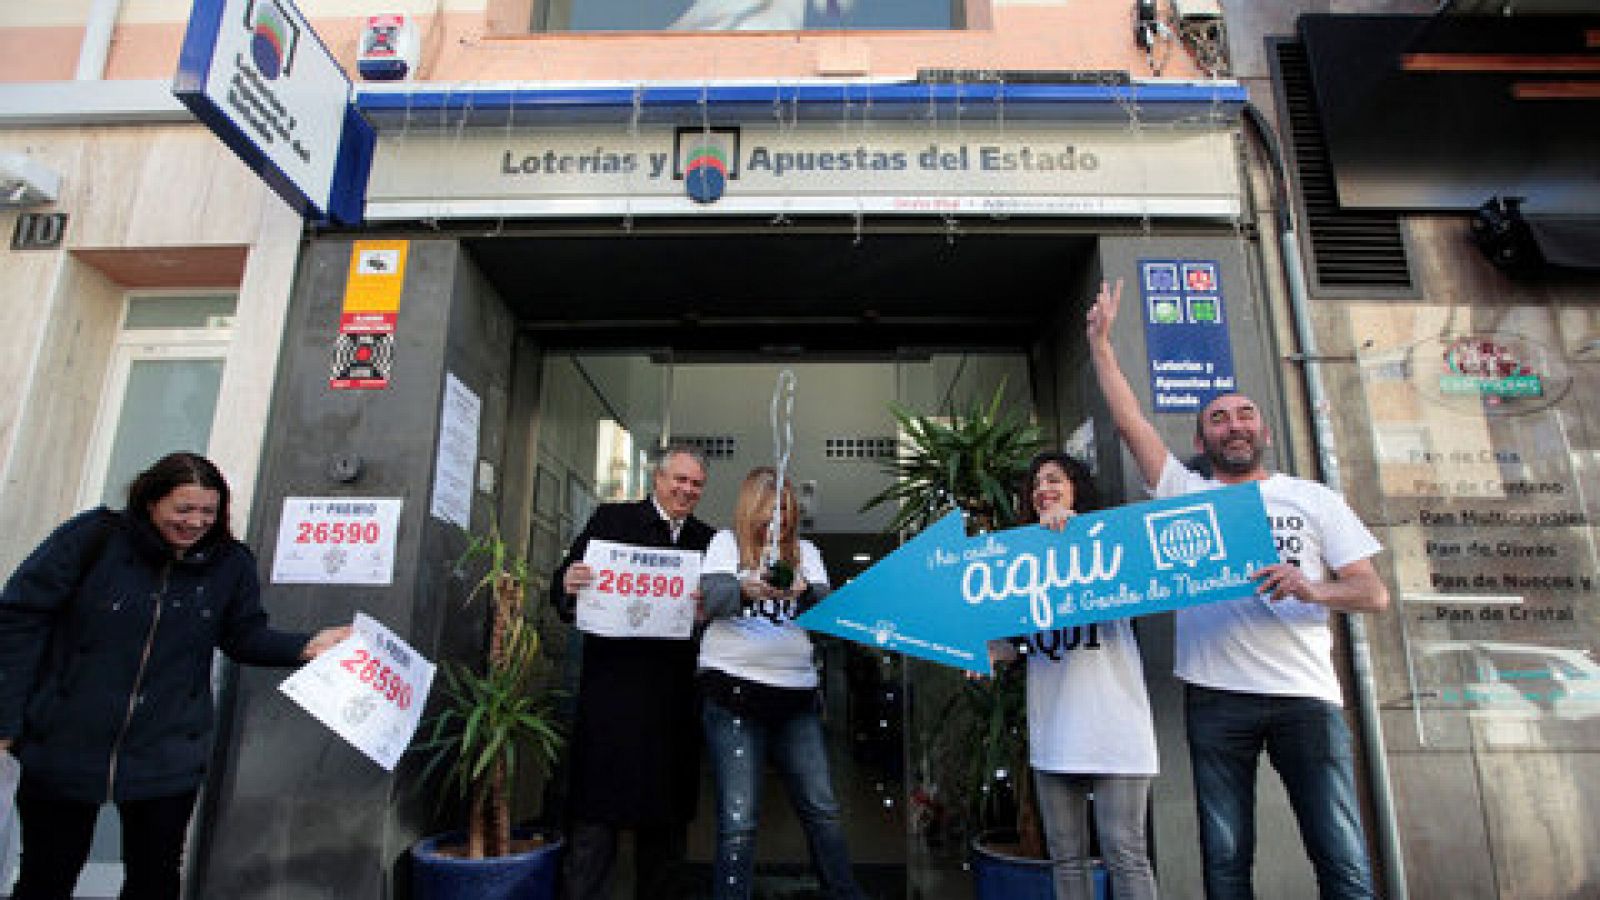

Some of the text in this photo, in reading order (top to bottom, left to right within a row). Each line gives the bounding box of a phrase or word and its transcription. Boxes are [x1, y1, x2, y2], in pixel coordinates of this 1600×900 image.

[502, 145, 1099, 178] Loterías y Apuestas del Estado
[1419, 509, 1456, 524] Pan
[295, 522, 380, 544] 26590
[1426, 540, 1460, 556] Pan
[1466, 540, 1491, 556] de
[599, 569, 685, 597] 26590
[963, 521, 1123, 628] aquí
[1430, 573, 1468, 588] Pan
[1472, 573, 1498, 588] de
[1436, 606, 1574, 621] Pan de Cristal
[340, 648, 414, 711] 26590
